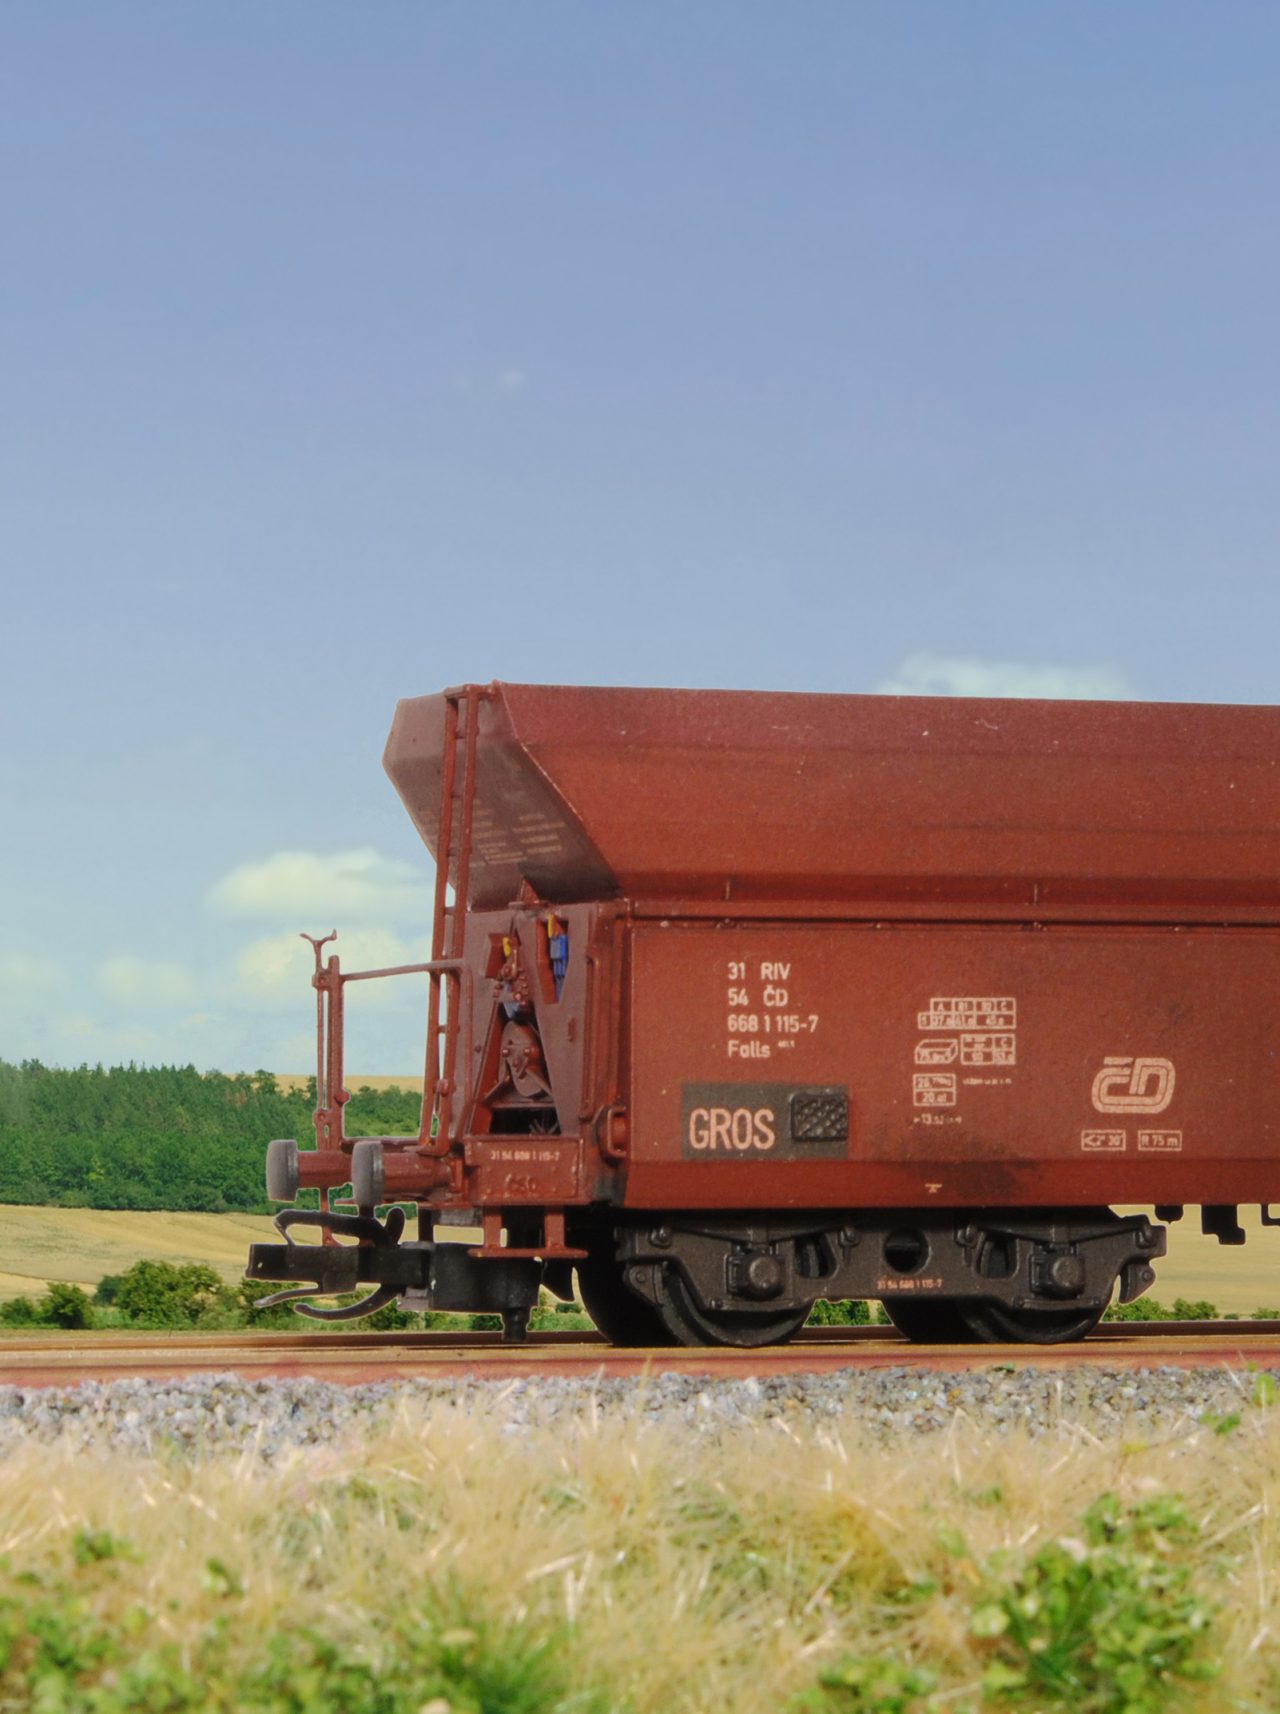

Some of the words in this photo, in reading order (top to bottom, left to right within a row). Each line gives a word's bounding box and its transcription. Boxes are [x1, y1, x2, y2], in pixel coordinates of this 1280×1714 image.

[728, 962, 746, 980] 31
[761, 962, 791, 980] RIV
[728, 988, 749, 1006] 54
[763, 984, 788, 1007] ČD
[728, 1014, 758, 1032] 668
[764, 1014, 770, 1032] 1
[775, 1014, 819, 1032] 115-7
[728, 1040, 770, 1058] Falls
[689, 1108, 775, 1150] GROS
[1151, 1134, 1165, 1146] 75
[1167, 1137, 1178, 1146] m
